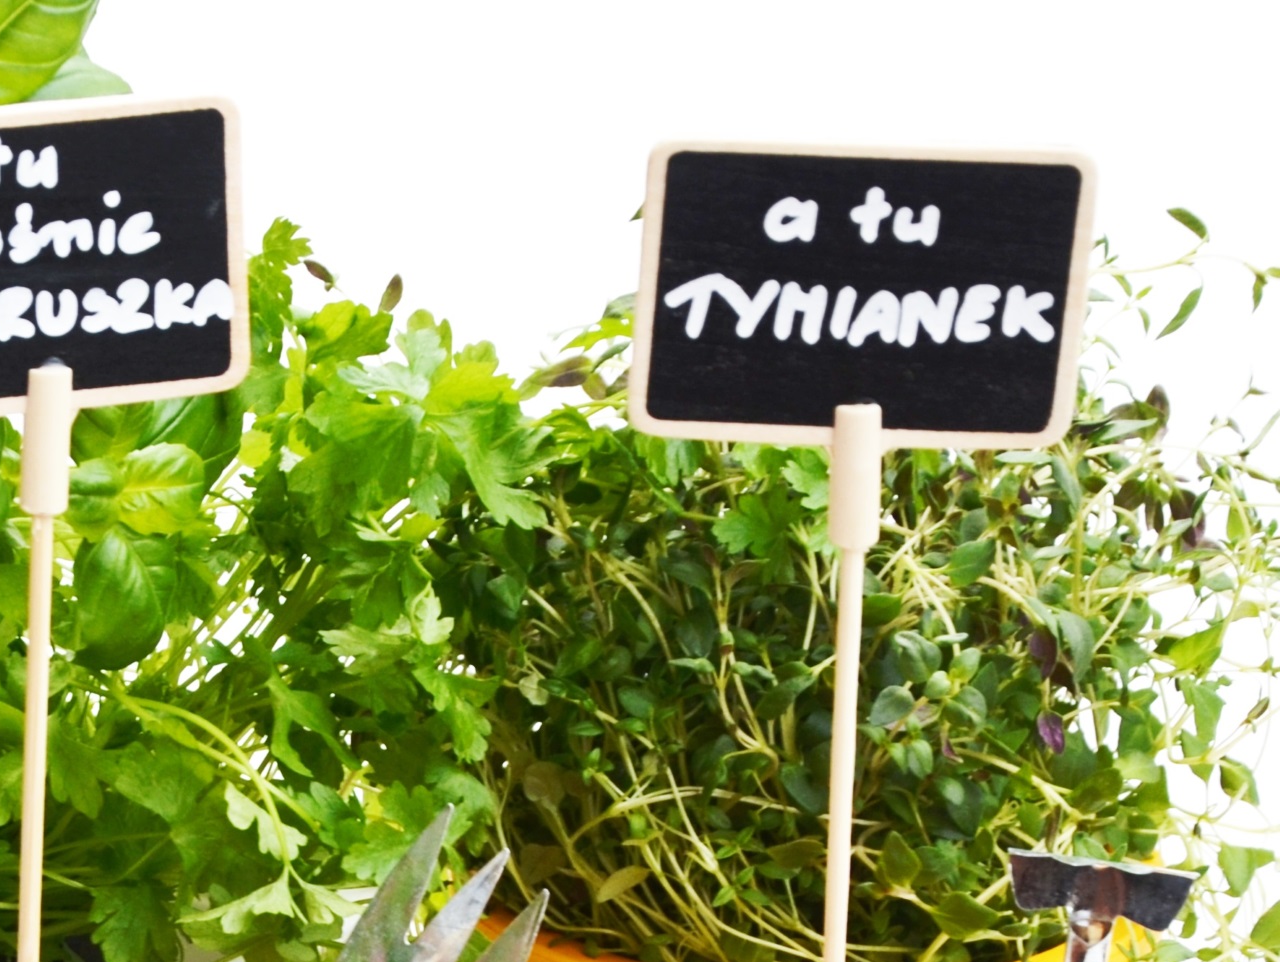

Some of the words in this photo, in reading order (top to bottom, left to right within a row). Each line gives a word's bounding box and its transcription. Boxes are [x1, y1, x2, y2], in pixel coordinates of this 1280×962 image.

[764, 197, 818, 242] a
[850, 187, 940, 246] tu
[664, 273, 1055, 347] TYMIANEK
